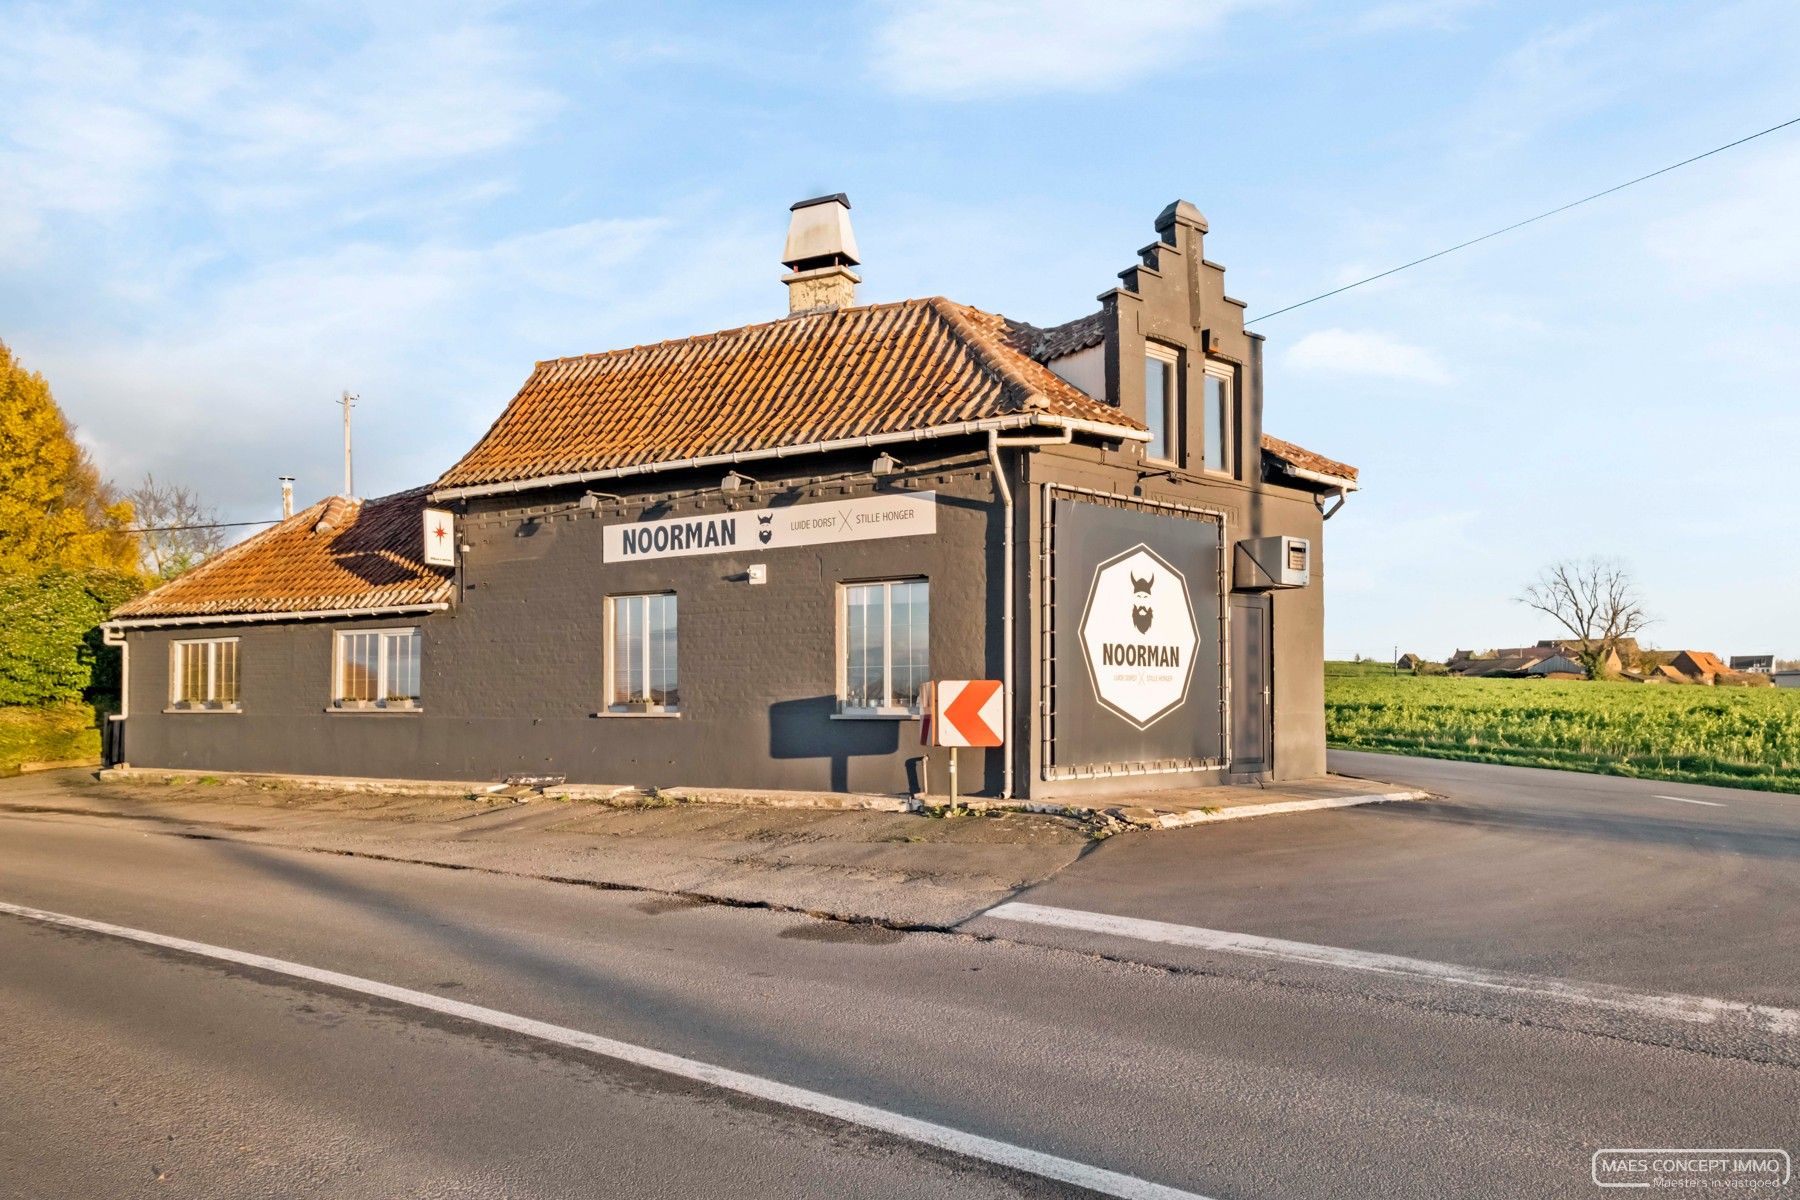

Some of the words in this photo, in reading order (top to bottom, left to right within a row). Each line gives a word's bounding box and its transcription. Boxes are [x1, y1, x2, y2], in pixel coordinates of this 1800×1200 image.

[790, 519, 811, 531] LUIDE
[812, 517, 836, 529] DORST
[855, 512, 880, 525] STILLE
[882, 509, 915, 521] HONGER
[622, 518, 736, 555] NOORMAN
[1102, 643, 1180, 667] NOORMAN
